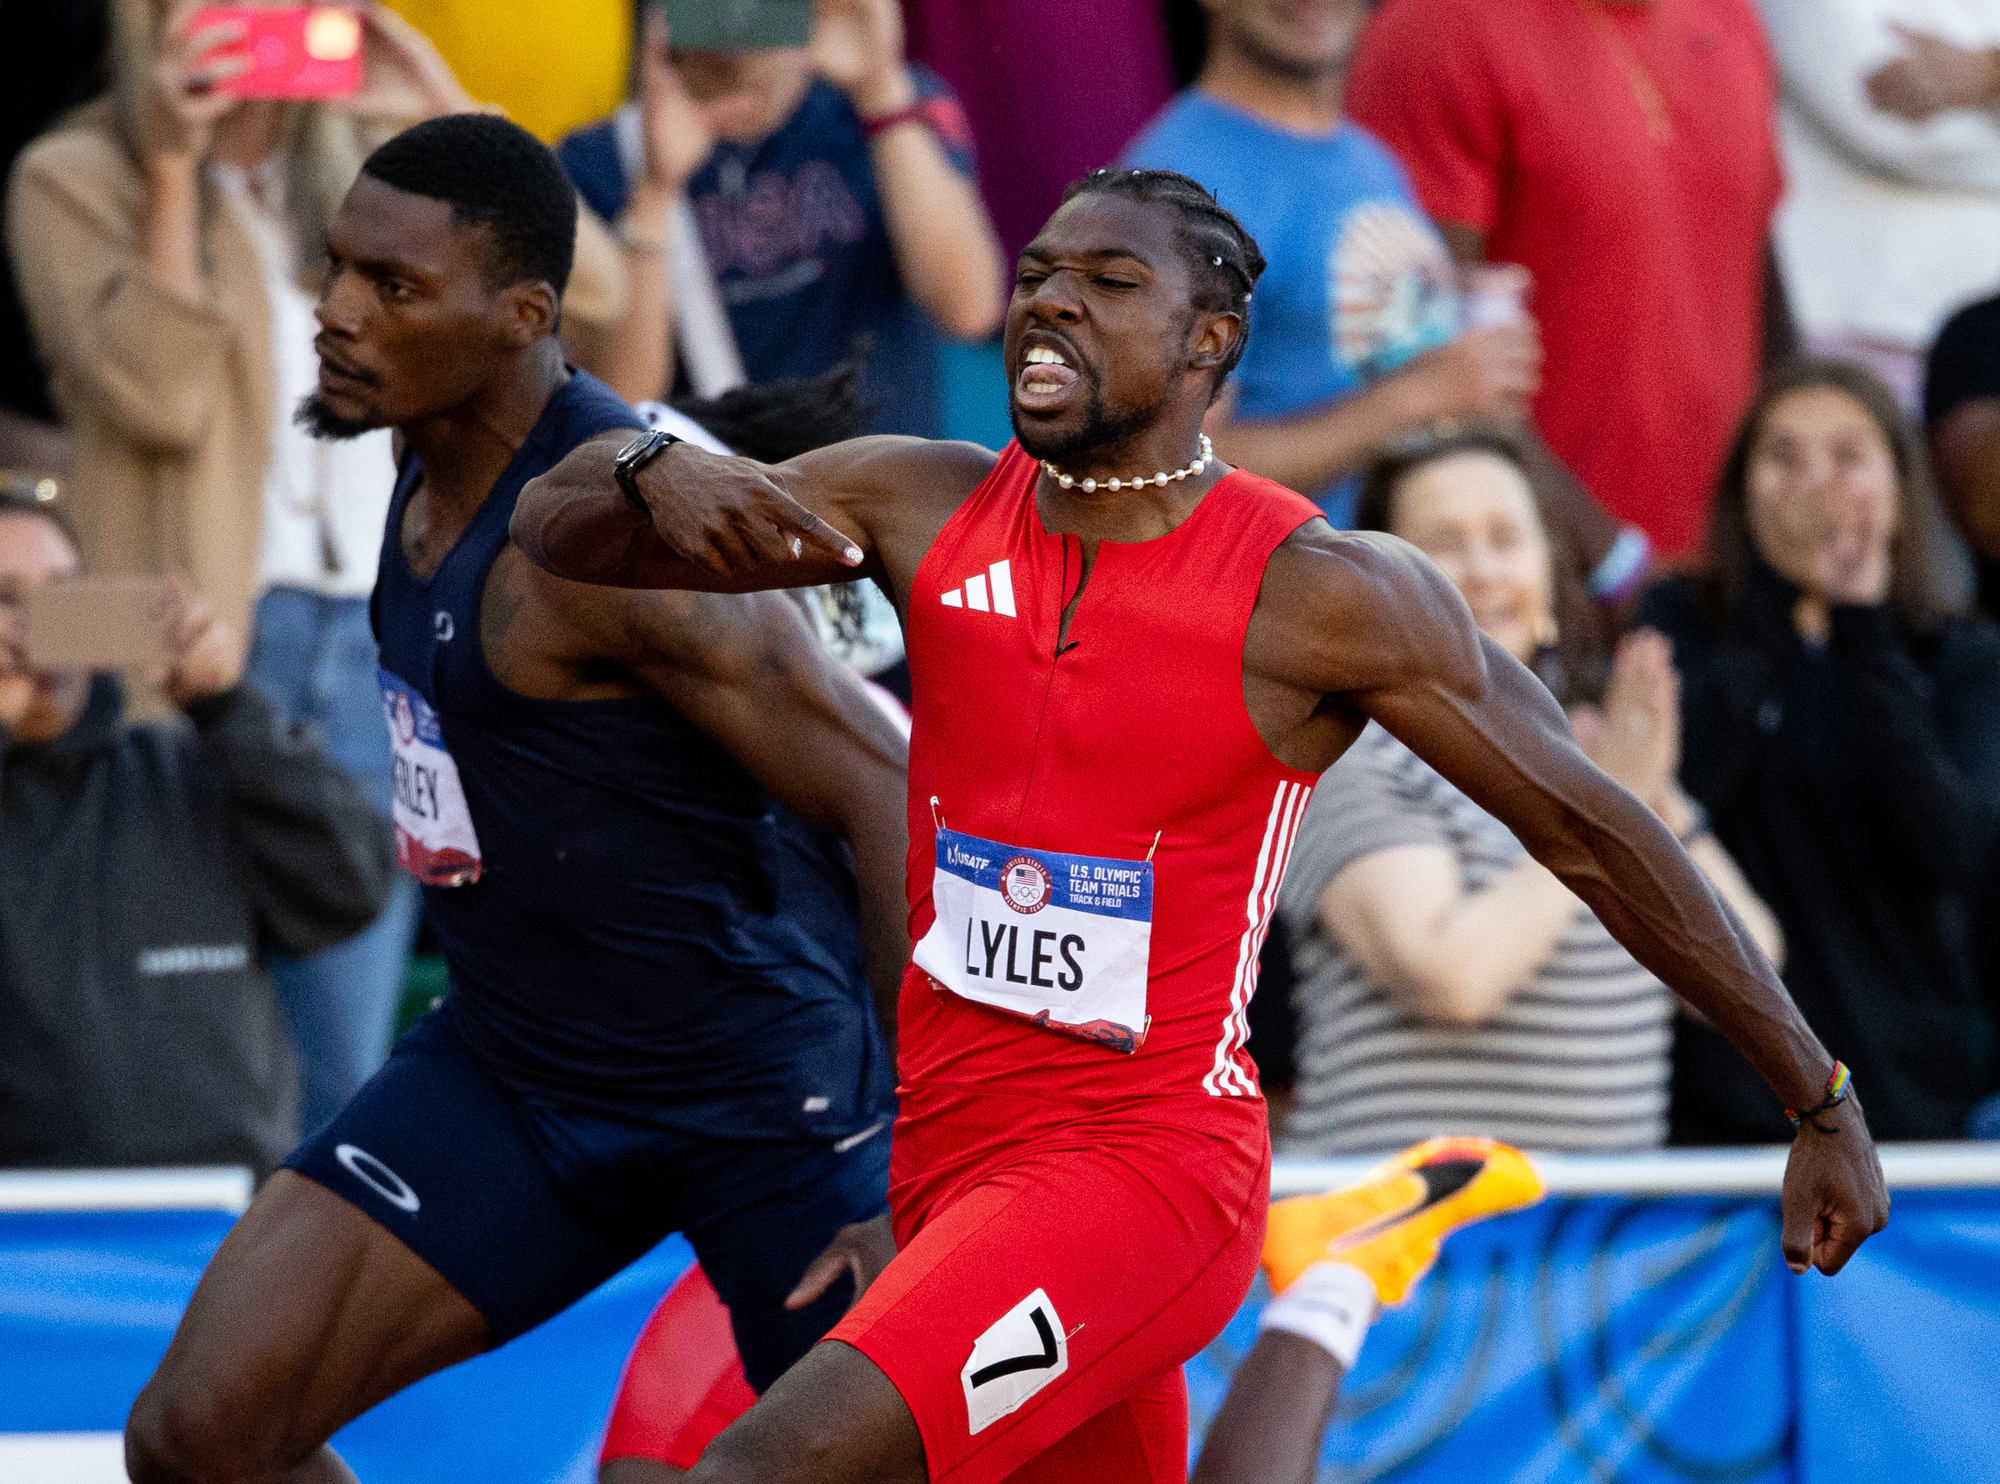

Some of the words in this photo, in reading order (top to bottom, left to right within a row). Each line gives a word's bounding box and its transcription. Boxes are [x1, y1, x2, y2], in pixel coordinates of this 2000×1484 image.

[957, 851, 990, 870] USATF
[1005, 857, 1026, 870] UNITED
[1026, 858, 1047, 875] STATES
[1070, 864, 1091, 879] U.S.
[1093, 867, 1141, 884] OLYMPIC
[1069, 878, 1099, 894] TEAM
[1101, 882, 1140, 898] TRIALS
[1004, 894, 1028, 914] OLYMPIC
[1029, 900, 1045, 914] TEAM
[1069, 893, 1093, 905] TRACK
[1094, 896, 1101, 906] &
[1101, 897, 1122, 908] FIELD
[967, 917, 1085, 992] LYLES
[969, 1305, 1058, 1390] 7
